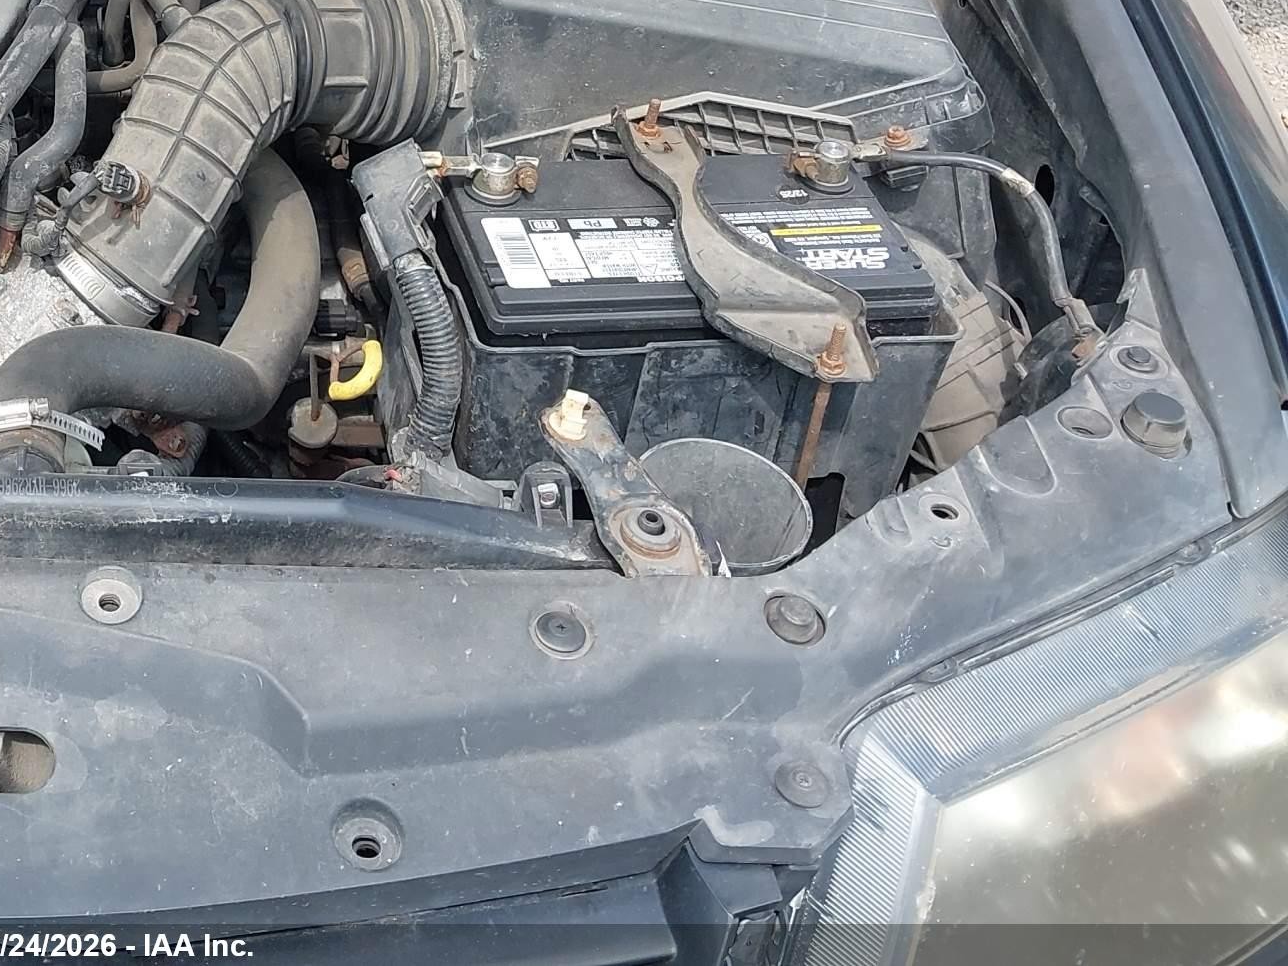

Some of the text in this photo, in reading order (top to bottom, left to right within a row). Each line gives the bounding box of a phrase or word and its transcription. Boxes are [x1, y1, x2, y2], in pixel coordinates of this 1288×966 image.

[583, 220, 602, 228] Pb
[803, 247, 890, 260] START
[804, 258, 886, 270] SUPER
